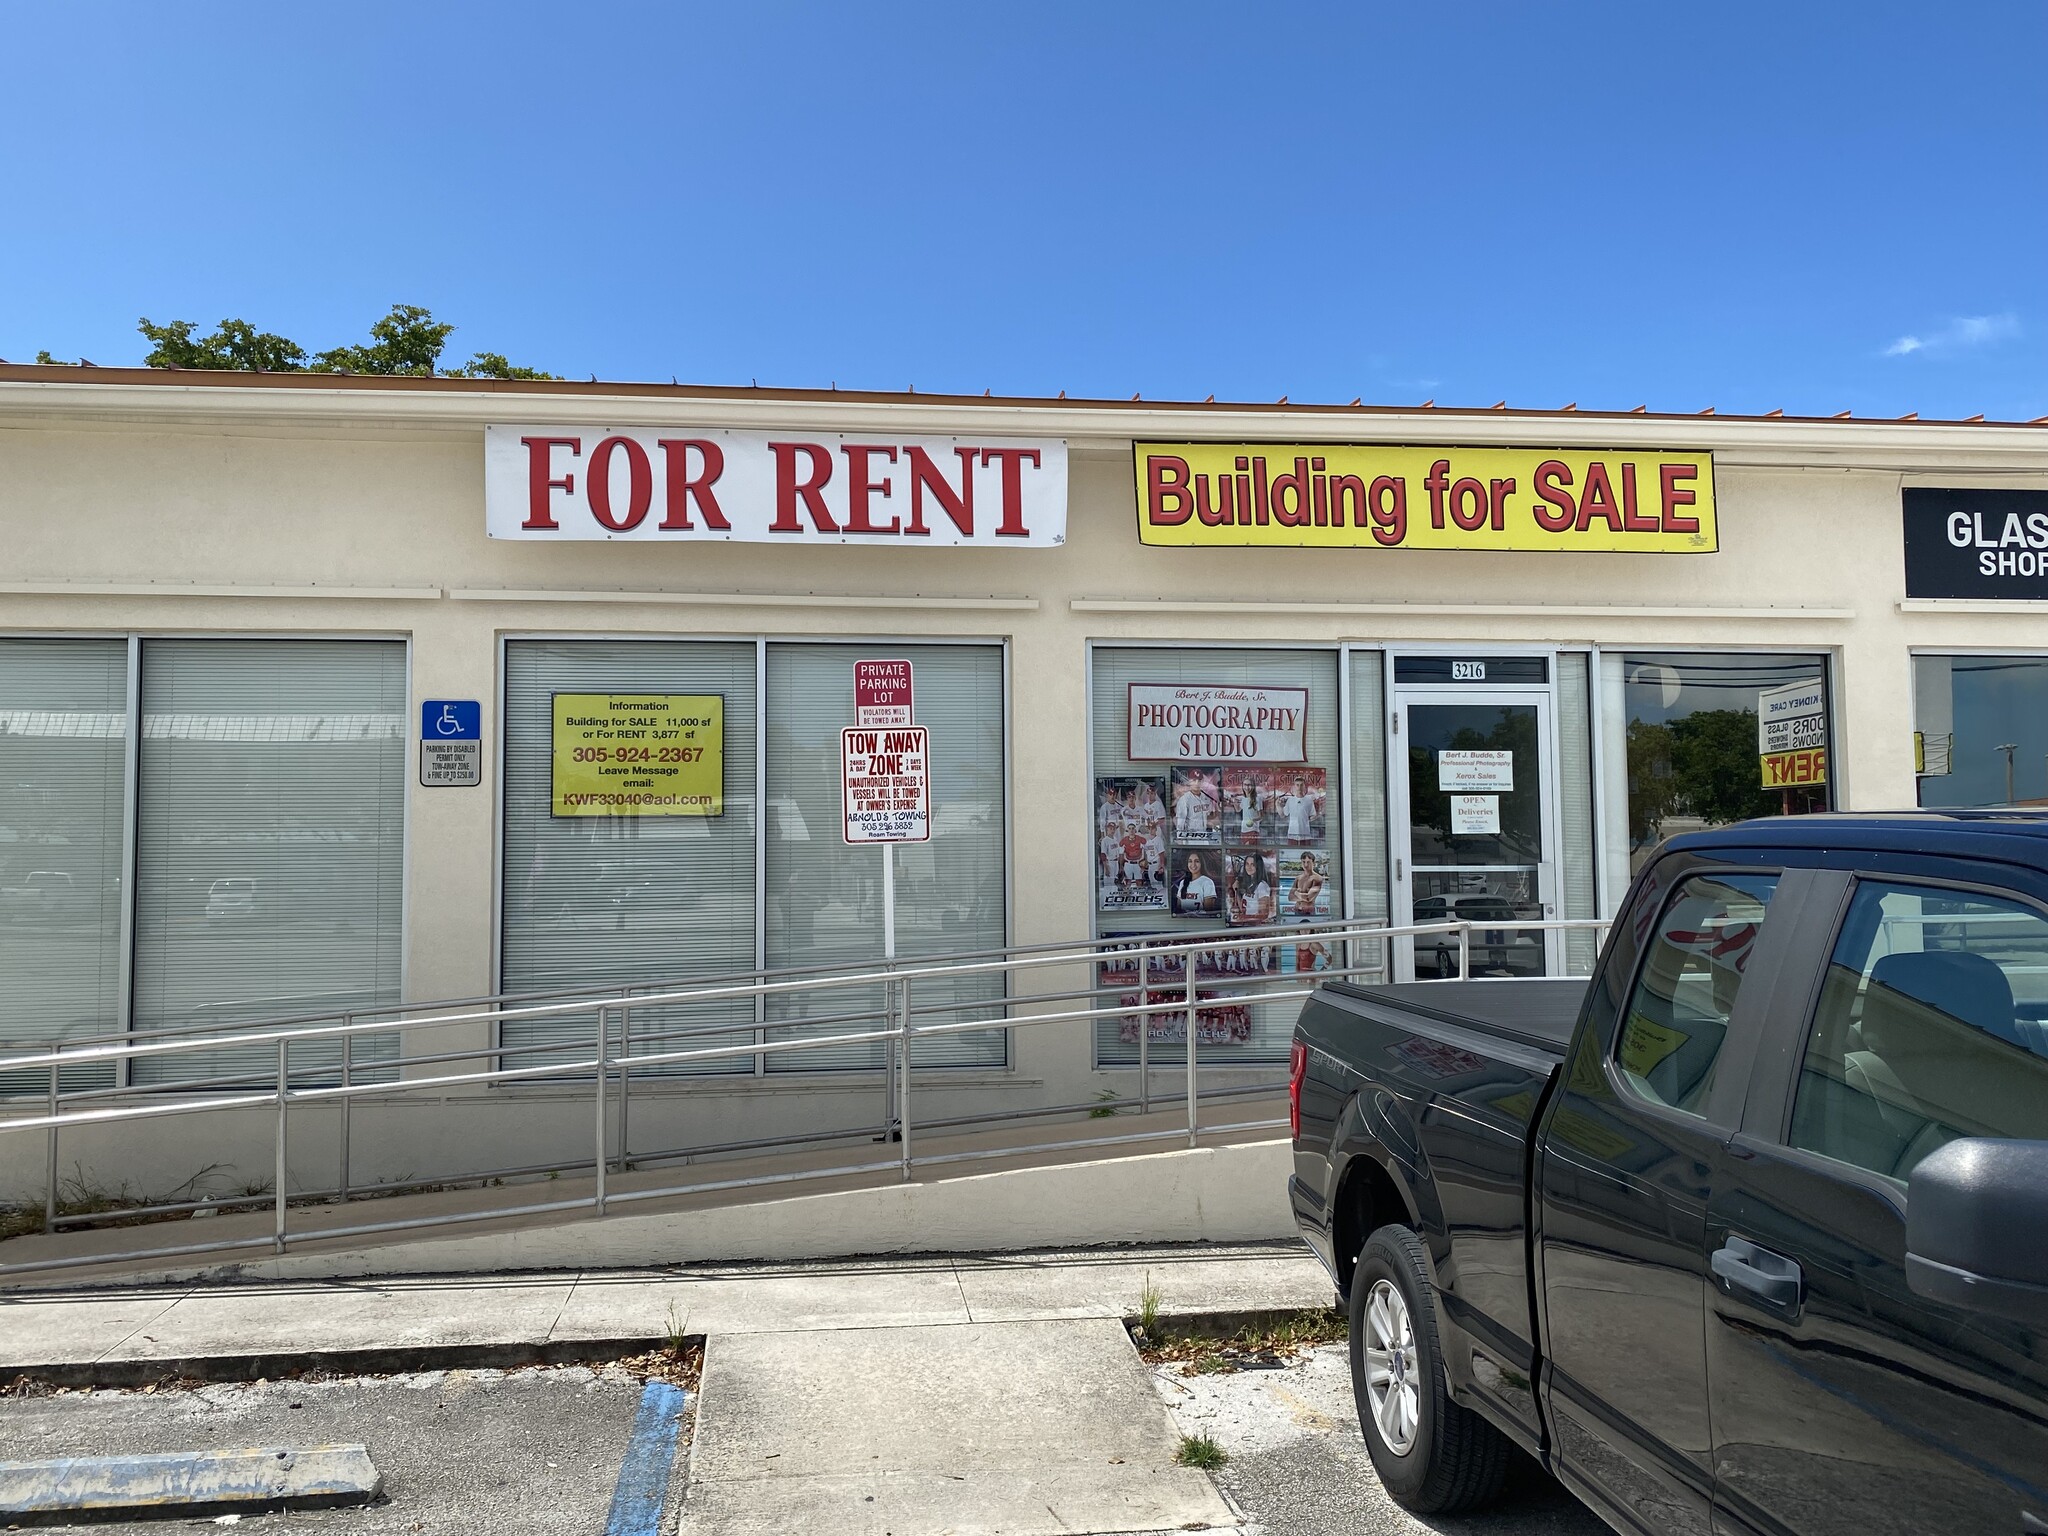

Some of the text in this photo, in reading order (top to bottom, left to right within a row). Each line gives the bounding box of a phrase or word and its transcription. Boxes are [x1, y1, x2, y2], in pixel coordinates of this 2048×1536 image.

[521, 434, 1041, 538] FOR RENT
[1146, 455, 1700, 546] Building for SALE
[861, 664, 905, 676] PRIVATE
[1454, 663, 1483, 678] 3216
[860, 678, 907, 690] PARKING
[874, 692, 893, 703] LOT
[1174, 690, 1267, 702] Bert J. Budde, Sr.
[609, 701, 669, 711] Information
[863, 708, 892, 716] VIOLATORS
[566, 717, 711, 727] Building for SALE 11,000 sf
[1137, 703, 1300, 731] PHOTOGRAPHY
[582, 730, 695, 740] or For RENT 3,877 sf
[426, 745, 446, 753] PARKING
[454, 745, 476, 753] DISABLED
[847, 732, 922, 754] TOW AWAY
[1180, 733, 1258, 757] STUDIO
[572, 747, 704, 763] 305-924-2367
[432, 762, 470, 770] TOW-AWAY ZONE
[598, 766, 679, 776] Leave Message
[868, 754, 903, 776] ZONE
[443, 771, 449, 779] UP
[450, 771, 456, 779] TO
[623, 779, 654, 788] email:
[848, 776, 890, 788] UNAUTHORIZED
[891, 776, 917, 787] VEHICLES
[563, 793, 713, 806] KWF33040@aol.com
[852, 787, 921, 800] VESSELS WILL BE TOWED
[857, 799, 917, 811] AT OWNER'S EXPENSE
[892, 811, 927, 821] TOWING
[861, 822, 877, 831] 305
[886, 831, 907, 839] Towing
[1104, 895, 1164, 903] CONCHS
[1309, 1049, 1353, 1077] SPORT
